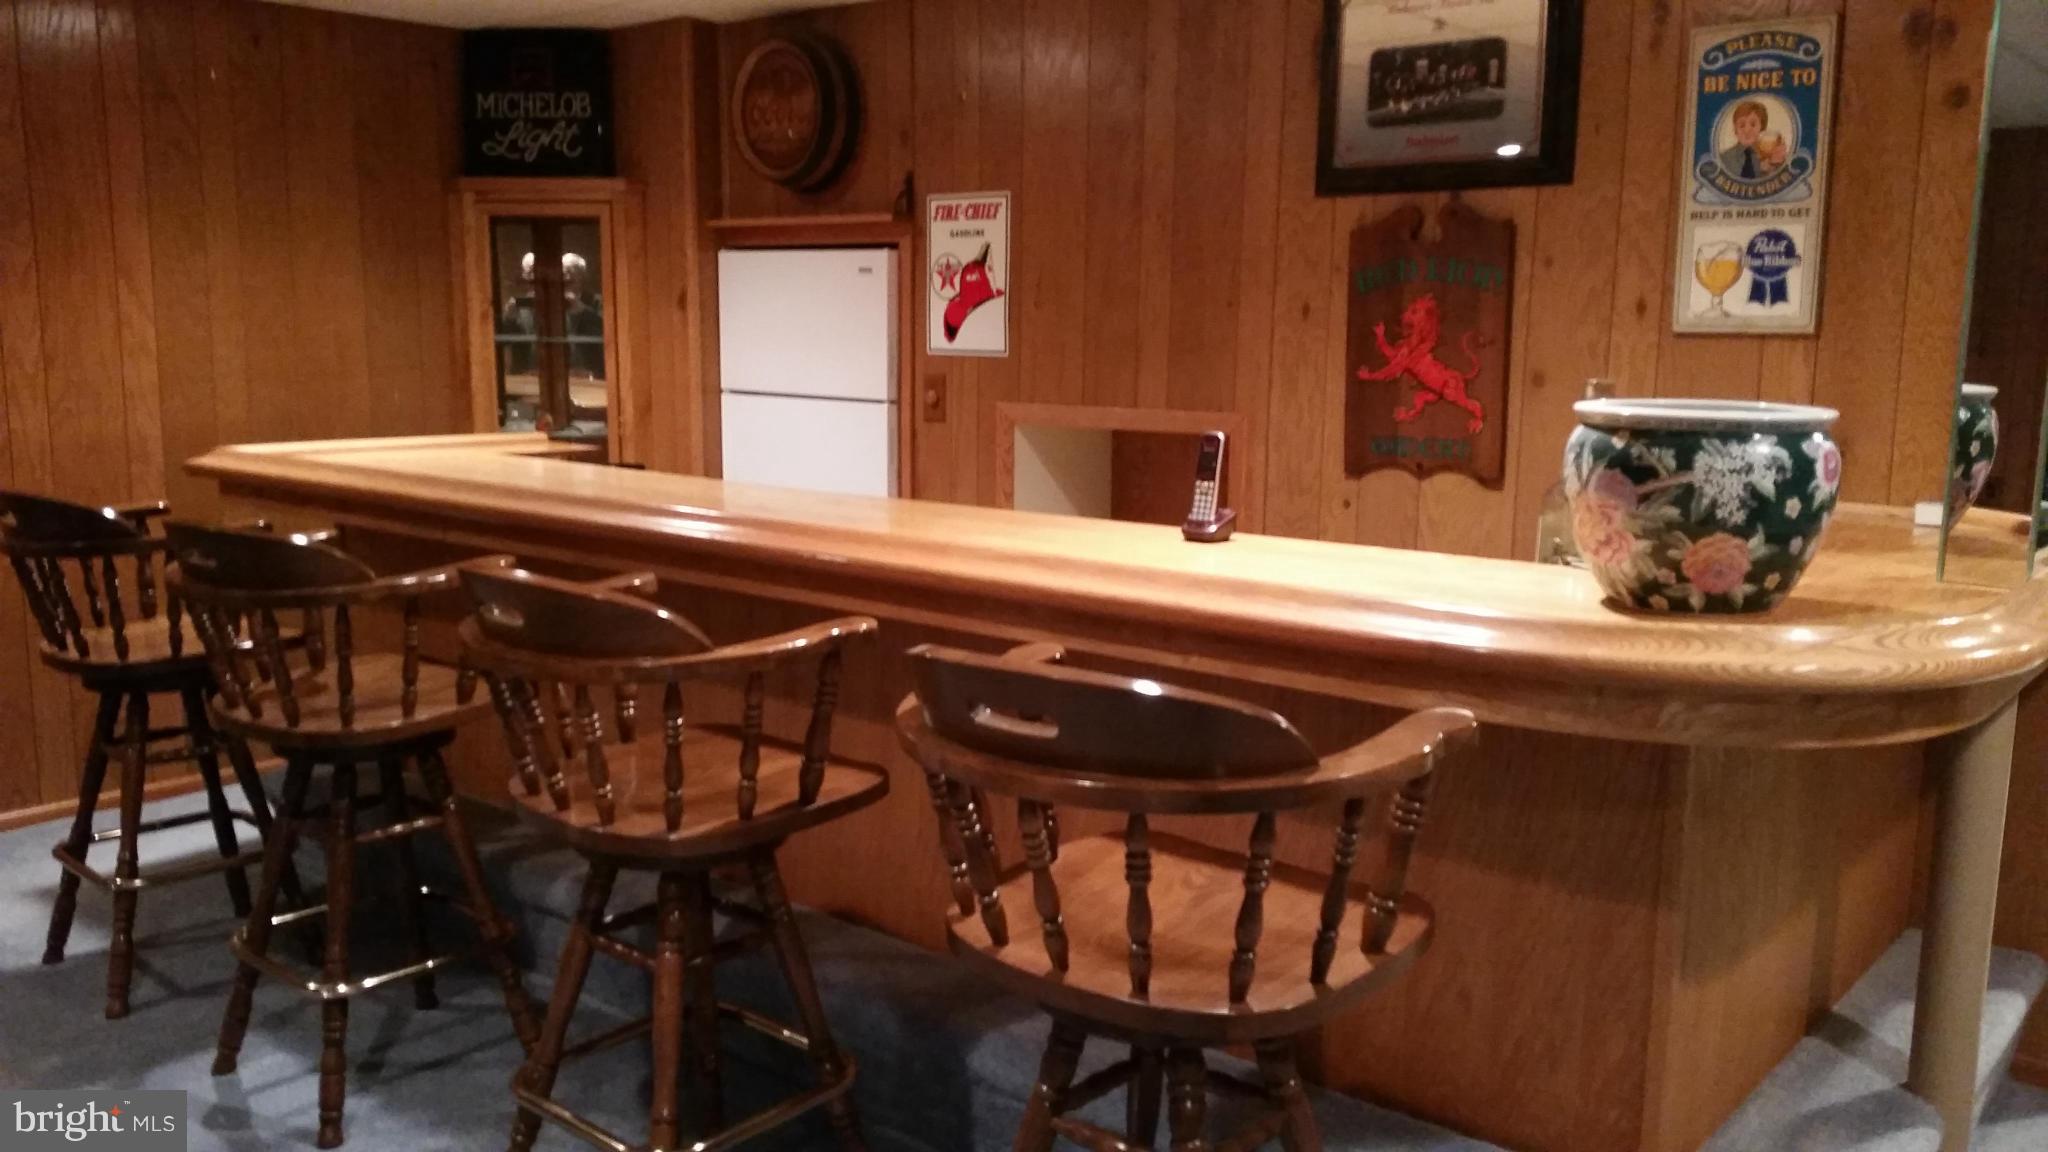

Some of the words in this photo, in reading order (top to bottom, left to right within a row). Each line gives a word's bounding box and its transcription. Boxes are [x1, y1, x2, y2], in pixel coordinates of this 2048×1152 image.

[1726, 32, 1796, 54] PLEASE
[1704, 75, 1729, 93] BE
[1737, 70, 1783, 91] NICE
[1791, 68, 1816, 86] TO
[475, 91, 592, 119] MICHELOB
[481, 120, 583, 162] Light
[1690, 210, 1717, 221] HELP
[1722, 210, 1733, 219] IS
[1736, 208, 1768, 219] HARD
[1772, 208, 1784, 218] TO
[1788, 207, 1811, 218] GET
[949, 229, 985, 239] GASOLINE
[1754, 235, 1788, 253] Pabst
